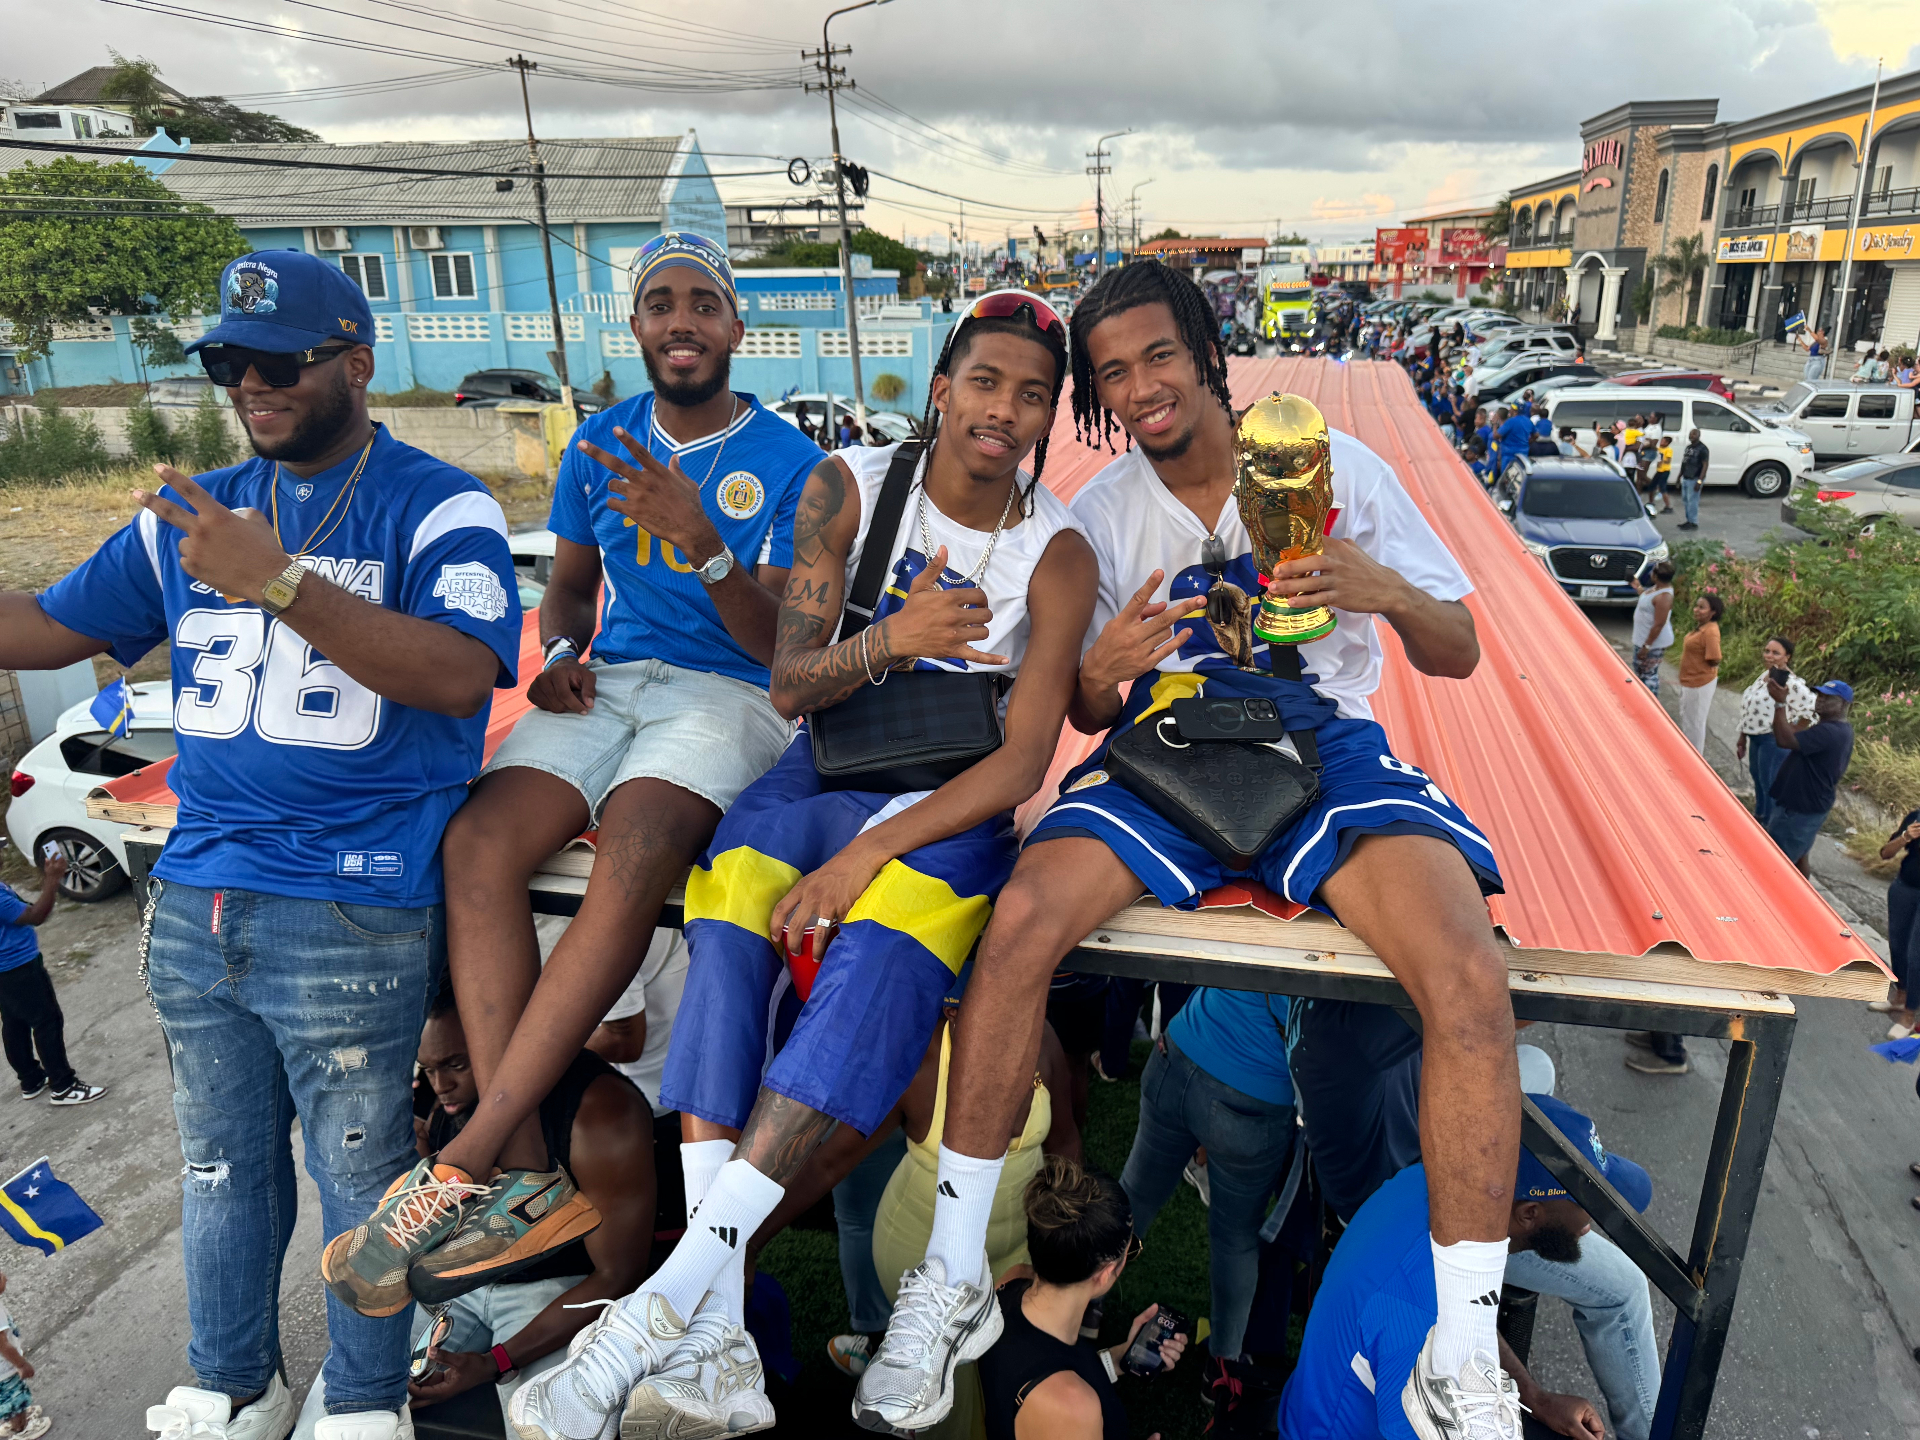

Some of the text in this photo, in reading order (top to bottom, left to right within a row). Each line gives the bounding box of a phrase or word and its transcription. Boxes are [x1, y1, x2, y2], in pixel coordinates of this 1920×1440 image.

[257, 262, 278, 280] Negra
[433, 578, 508, 608] ARIZONA
[174, 608, 382, 750] 36
[344, 854, 363, 867] USA
[1529, 1188, 1545, 1197] Ola
[1158, 1316, 1175, 1330] 6:03
